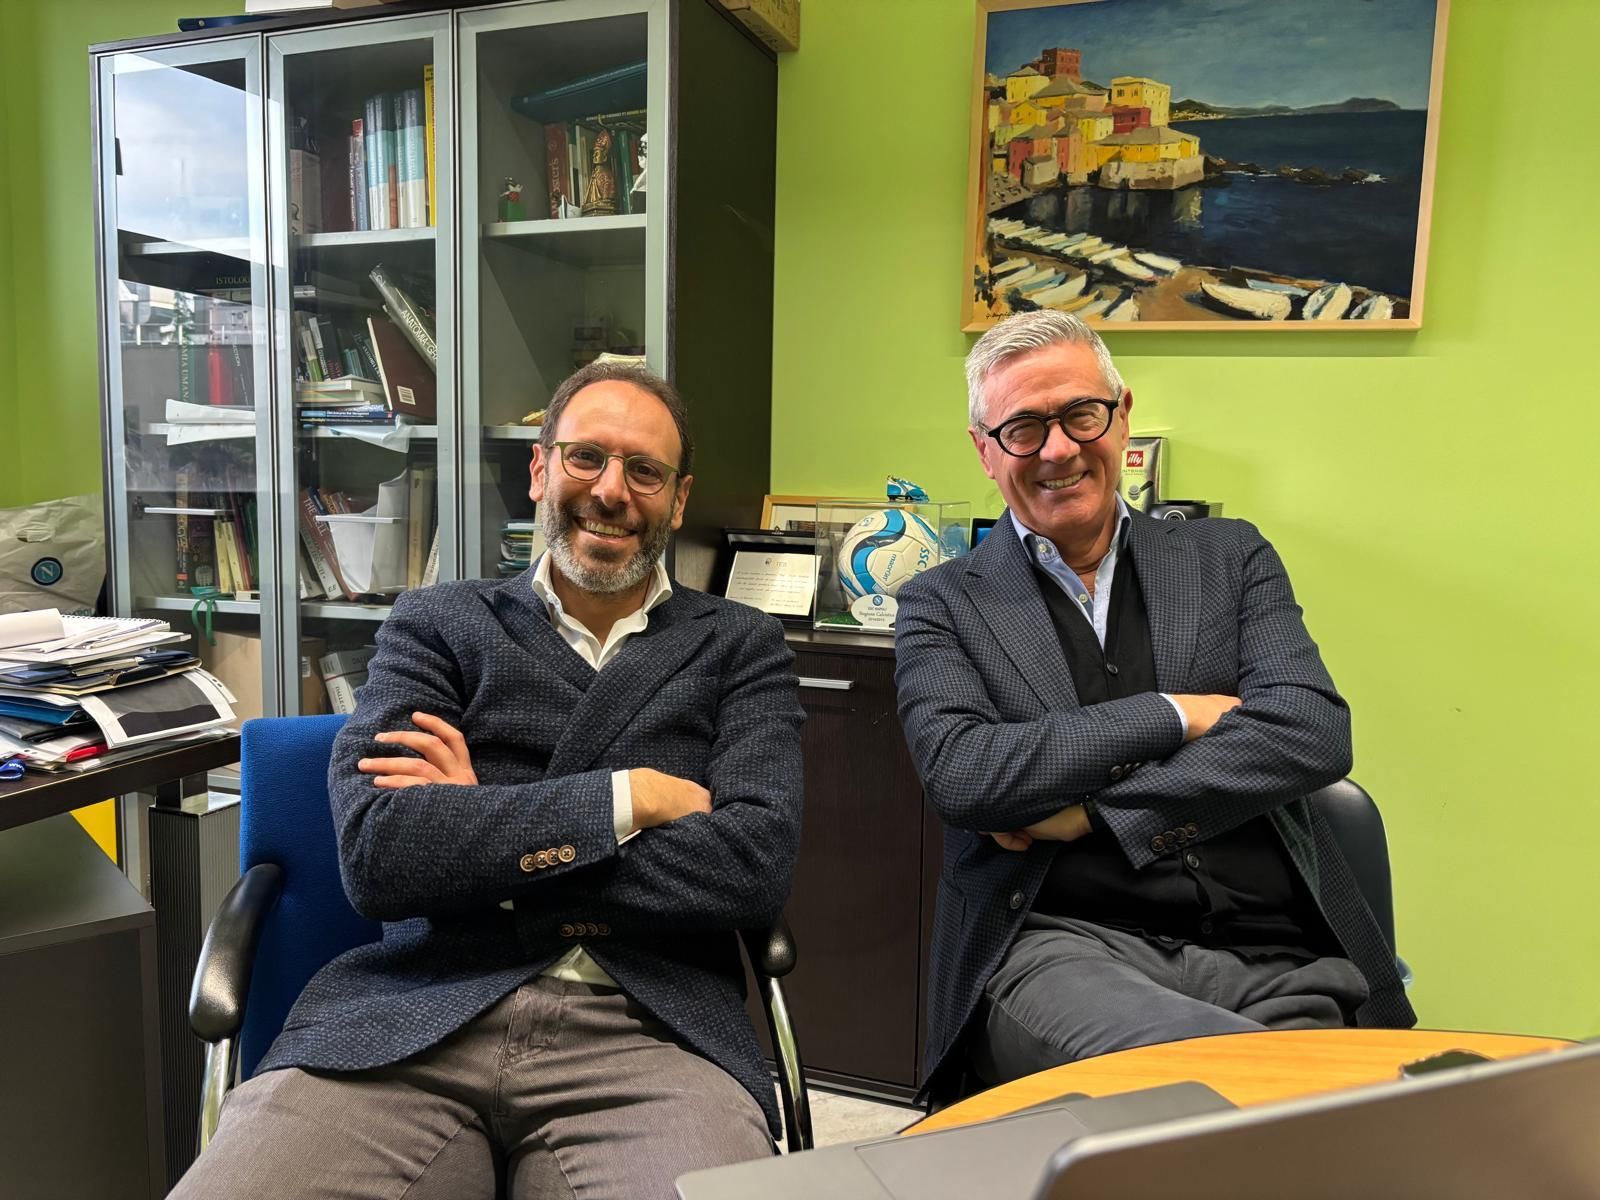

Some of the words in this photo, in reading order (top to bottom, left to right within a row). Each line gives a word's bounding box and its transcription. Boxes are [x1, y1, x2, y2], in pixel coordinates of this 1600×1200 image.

[401, 310, 429, 346] ANATOMIA
[1127, 452, 1142, 466] illy
[883, 553, 896, 581] macron
[917, 547, 929, 568] SSC
